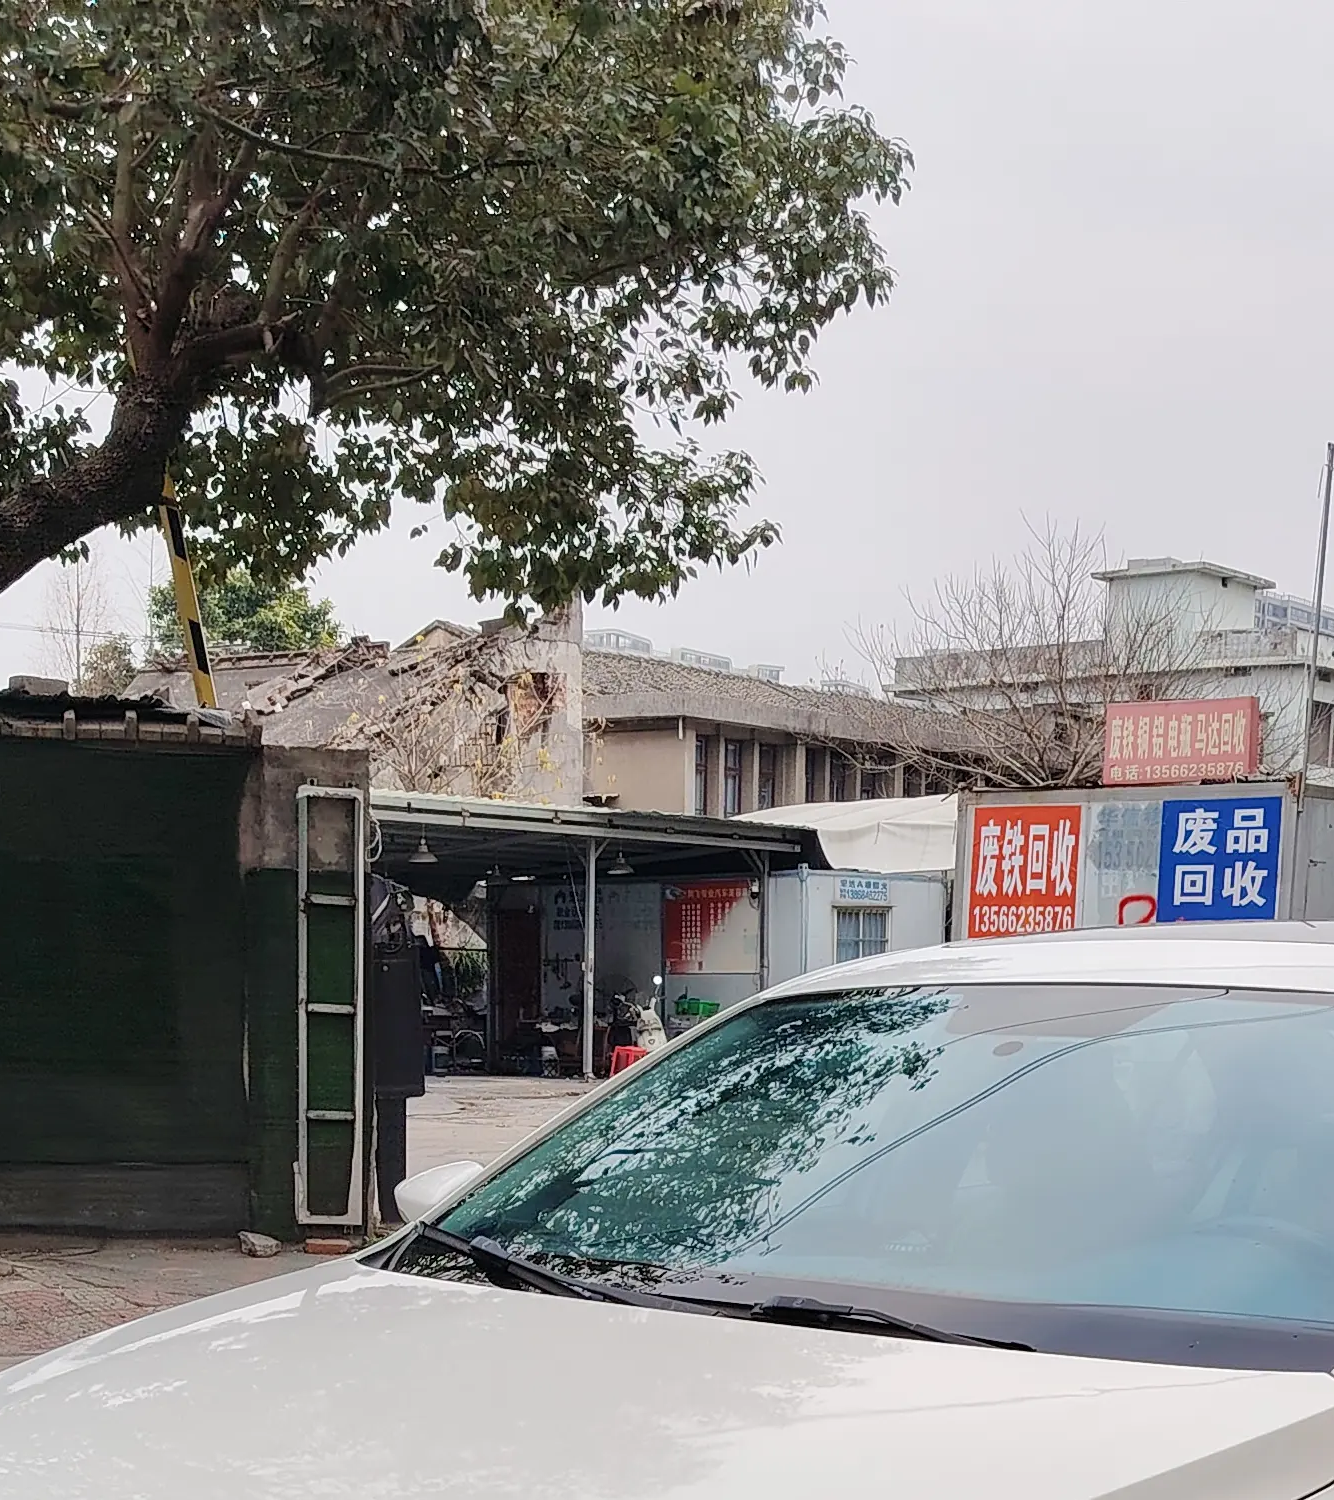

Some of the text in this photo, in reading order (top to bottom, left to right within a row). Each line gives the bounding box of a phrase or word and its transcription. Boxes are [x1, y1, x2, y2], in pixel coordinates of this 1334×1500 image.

[1172, 807, 1269, 856] 废品
[975, 818, 1076, 898] 废铁回收
[1173, 861, 1268, 907] 回收
[973, 904, 1073, 933] 13566235876
